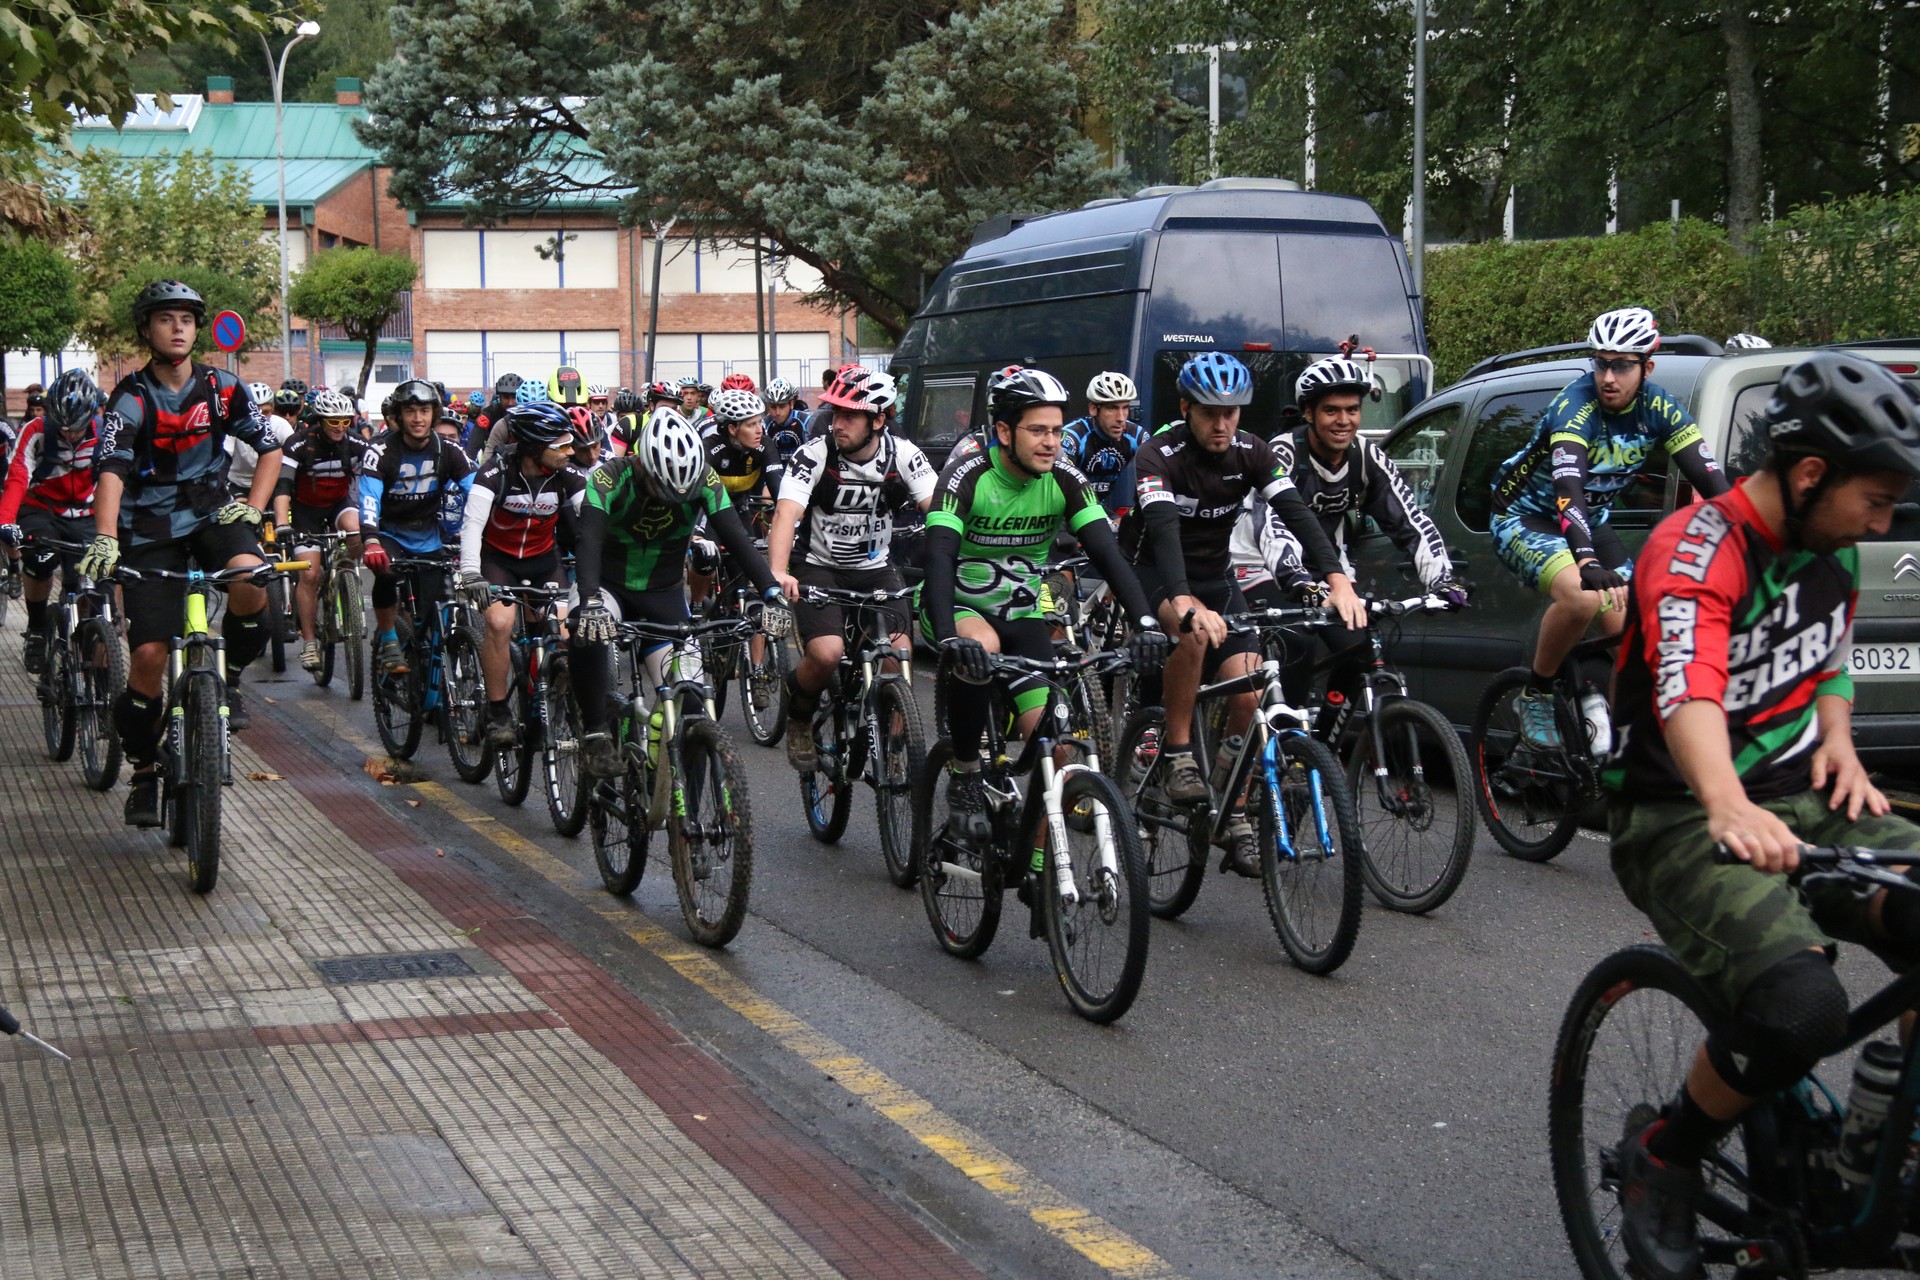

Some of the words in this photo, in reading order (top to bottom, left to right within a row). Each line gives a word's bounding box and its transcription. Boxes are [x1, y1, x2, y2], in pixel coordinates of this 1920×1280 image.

[1163, 334, 1215, 343] WESTFALIA
[947, 455, 987, 494] TELLERIARTE
[966, 513, 1059, 531] TELLERIARTE
[1852, 647, 1911, 671] 6032
[168, 718, 182, 756] FOX
